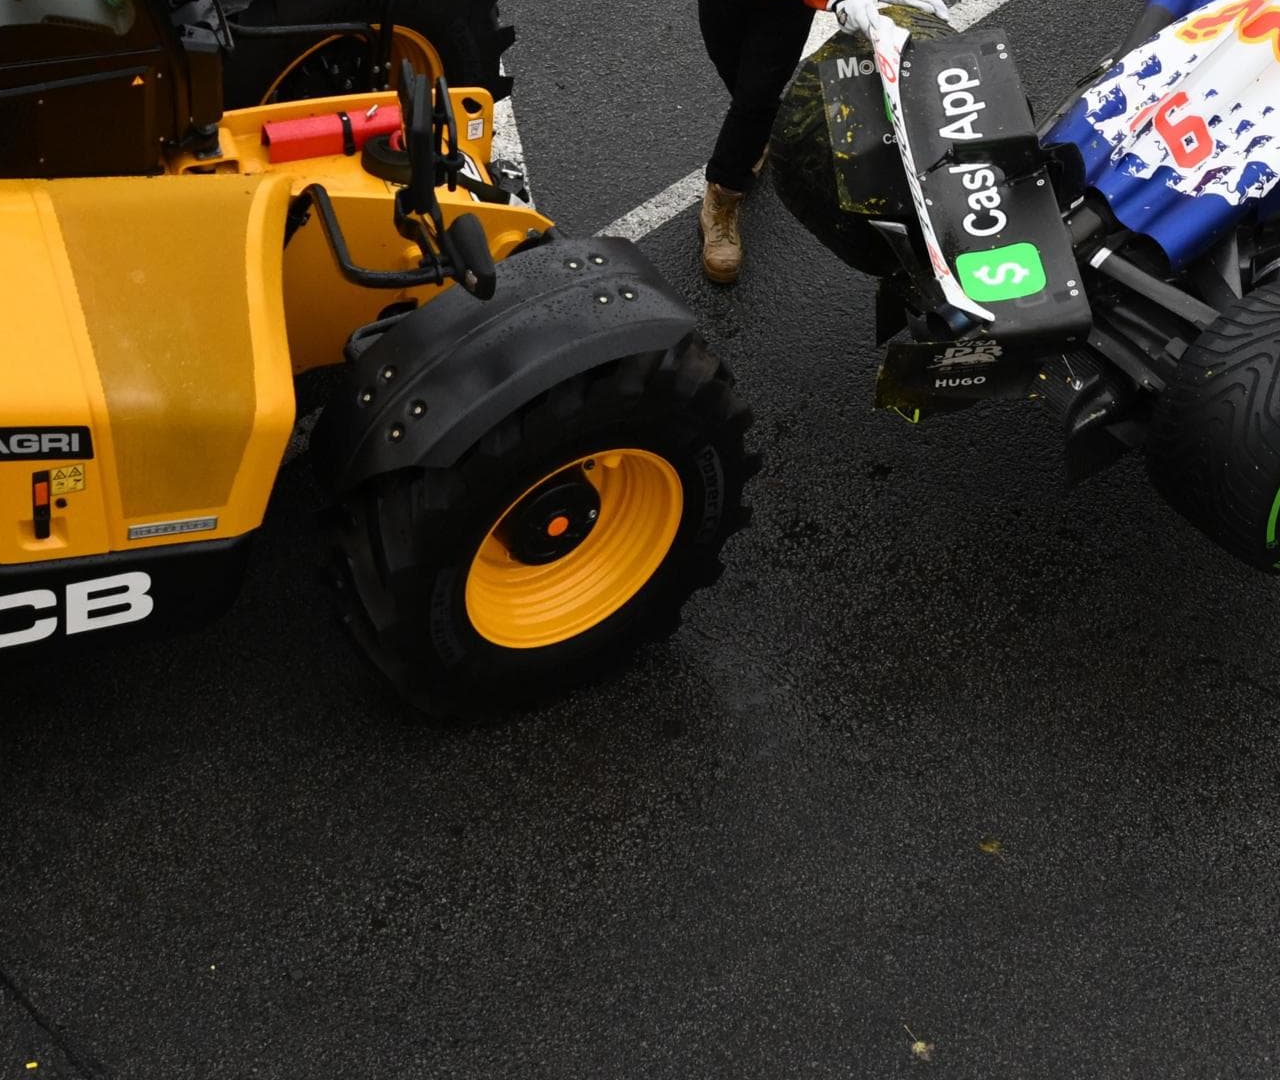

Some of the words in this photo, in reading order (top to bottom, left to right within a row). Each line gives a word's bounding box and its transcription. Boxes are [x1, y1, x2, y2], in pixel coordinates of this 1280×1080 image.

[937, 68, 986, 140] App
[1154, 91, 1213, 169] 6
[935, 376, 986, 388] HUGO
